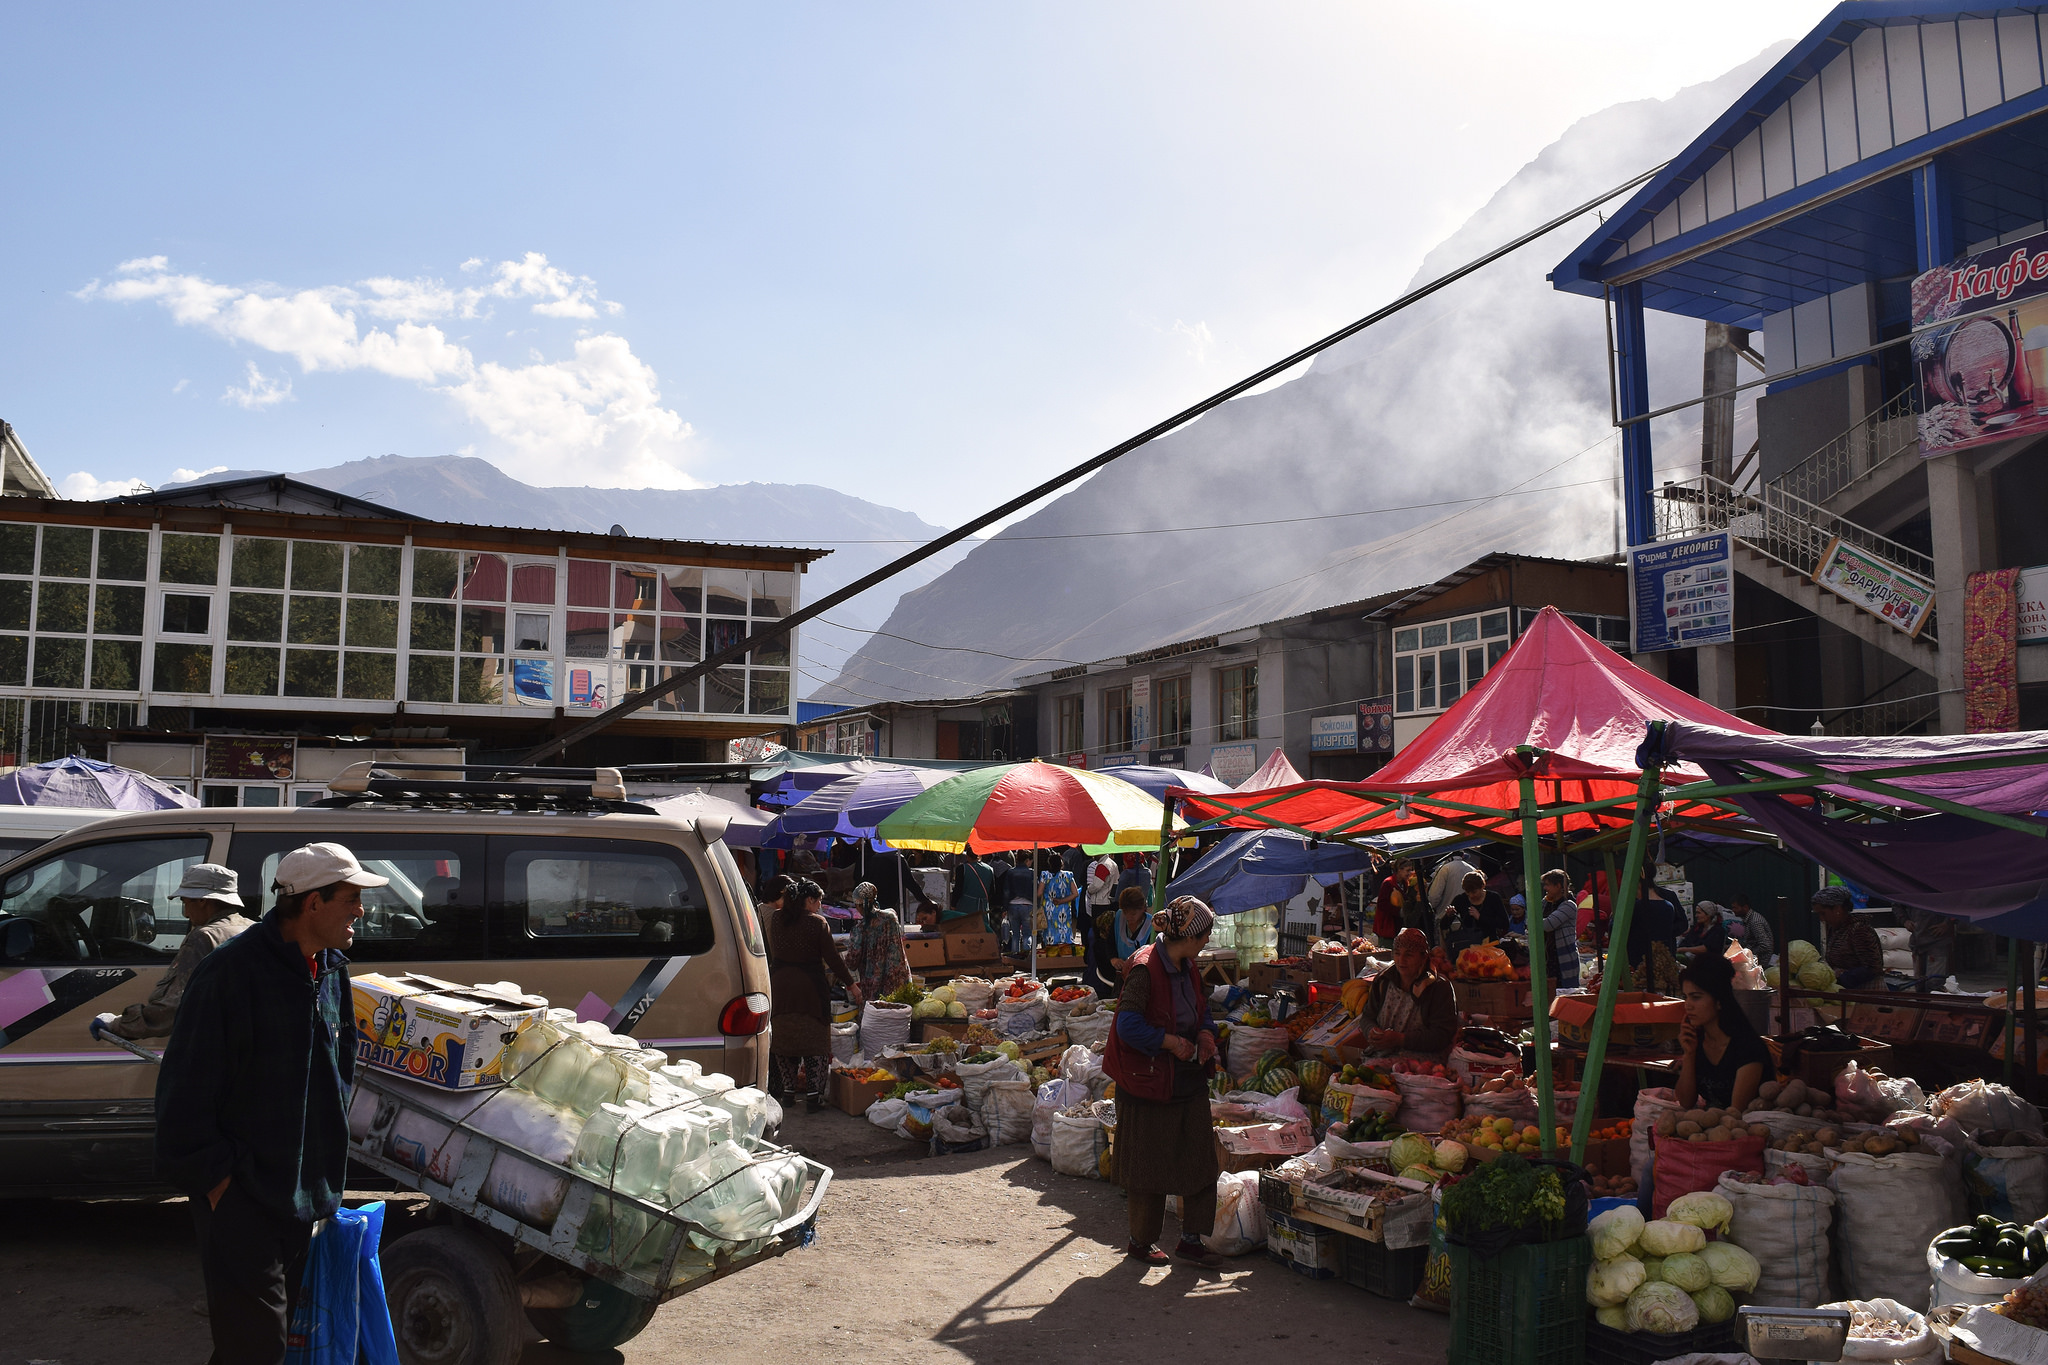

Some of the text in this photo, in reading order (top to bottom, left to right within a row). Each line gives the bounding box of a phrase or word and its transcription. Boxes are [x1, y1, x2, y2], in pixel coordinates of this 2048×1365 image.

[1946, 247, 2048, 305] Кафе
[1637, 550, 1668, 564] Фирма
[1849, 571, 1903, 607] ФАРИДУН
[95, 969, 126, 977] SVX
[628, 993, 655, 1023] SVX
